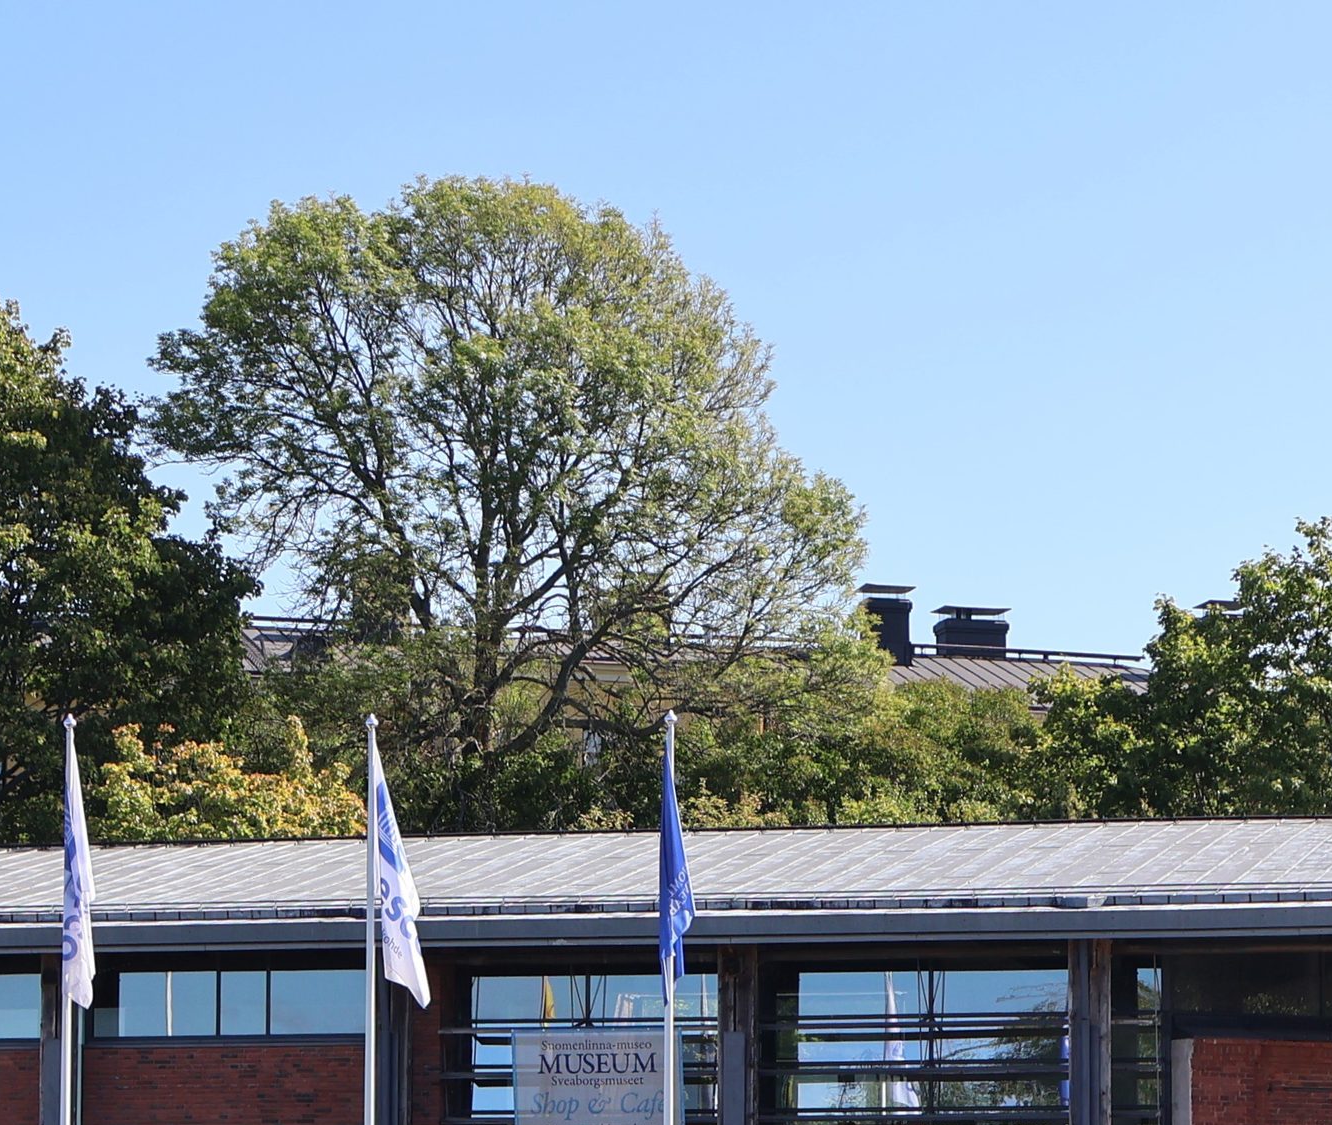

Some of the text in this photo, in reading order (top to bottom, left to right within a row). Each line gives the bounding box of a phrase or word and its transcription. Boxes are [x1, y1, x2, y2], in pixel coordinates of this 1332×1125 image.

[541, 1039, 652, 1051] Suomenlinna-museo
[538, 1052, 657, 1075] MUSEUM
[551, 1075, 644, 1088] Sveaborgsmuseet
[531, 1091, 580, 1120] Shop
[588, 1092, 611, 1114] &
